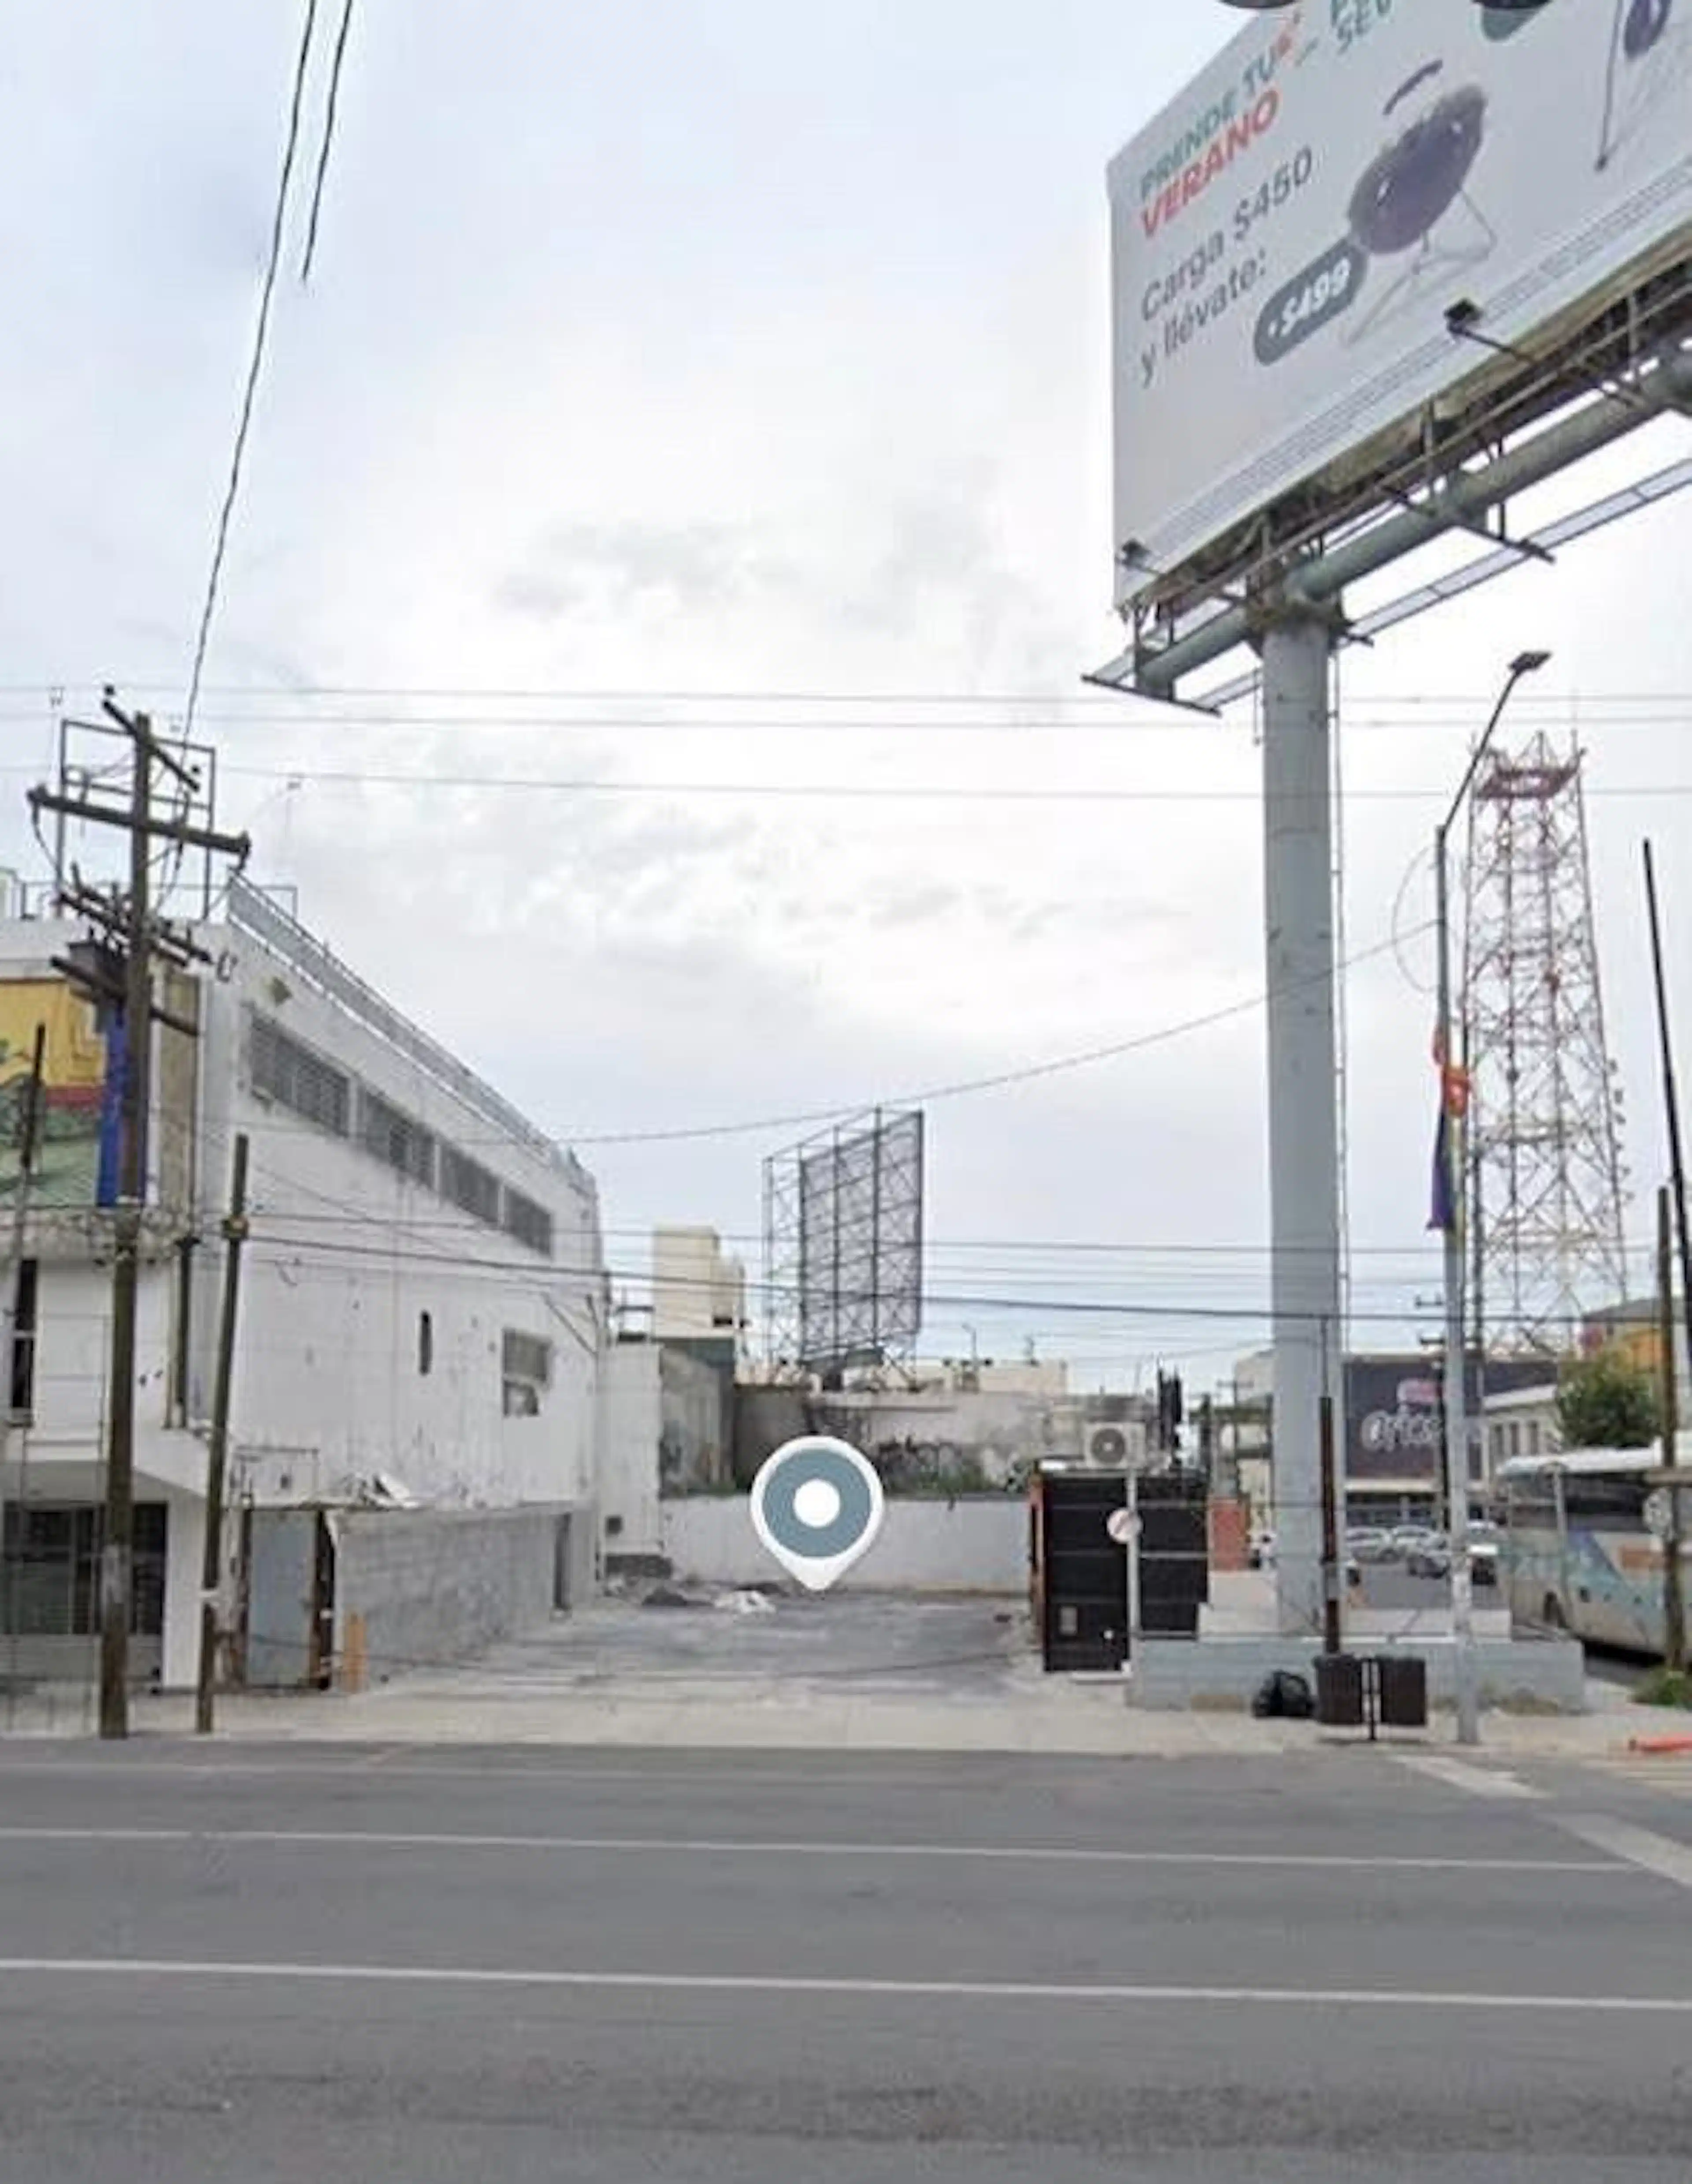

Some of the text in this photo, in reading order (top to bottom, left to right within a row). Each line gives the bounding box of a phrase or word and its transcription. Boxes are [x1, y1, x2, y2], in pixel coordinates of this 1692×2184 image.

[1243, 44, 1277, 97] TU
[1140, 89, 1280, 239] VERANO
[1142, 229, 1225, 322] Carga
[1142, 342, 1157, 389] y
